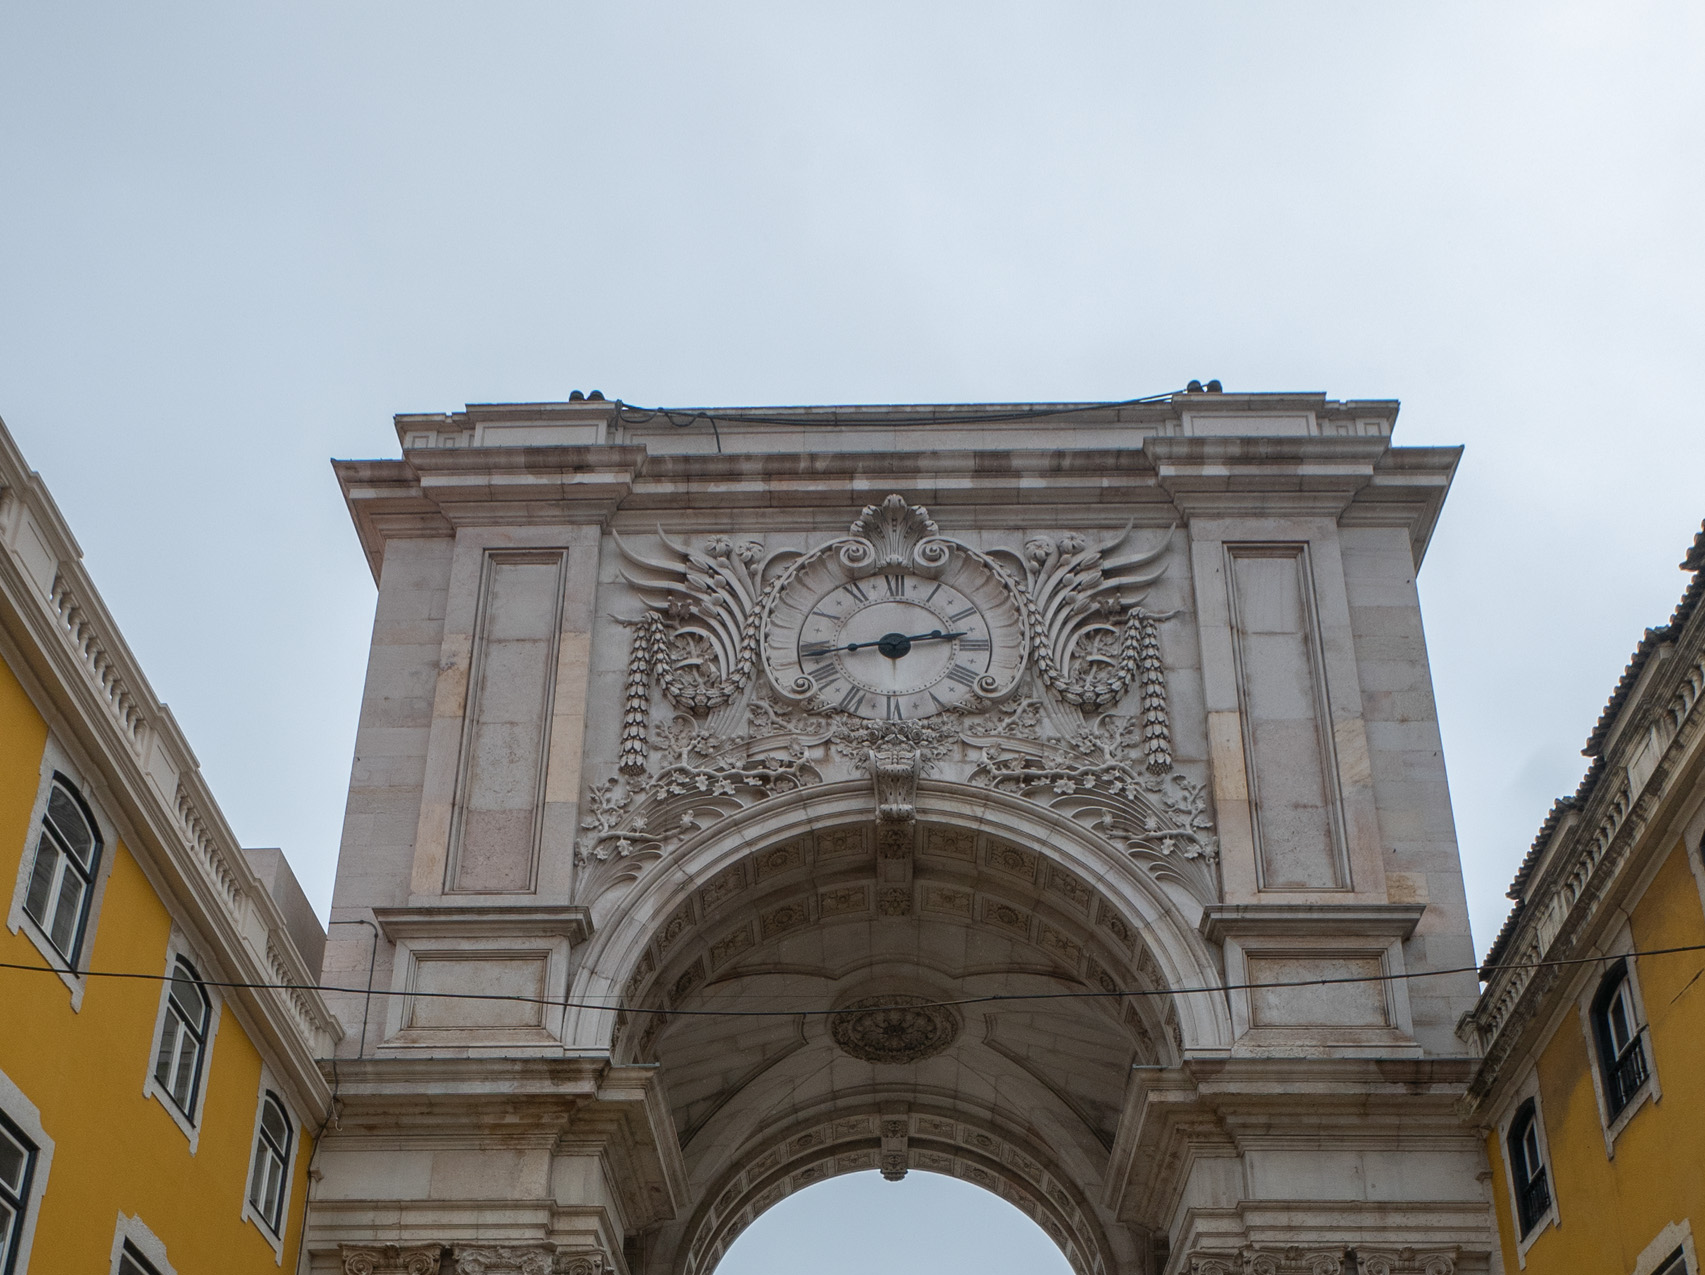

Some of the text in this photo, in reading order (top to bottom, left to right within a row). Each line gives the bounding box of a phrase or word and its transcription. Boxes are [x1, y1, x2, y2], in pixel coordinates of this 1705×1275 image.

[842, 581, 870, 607] XI
[883, 574, 905, 597] XII
[811, 606, 841, 625] X
[949, 605, 978, 624] II
[959, 639, 990, 652] III
[886, 696, 904, 721] VI
